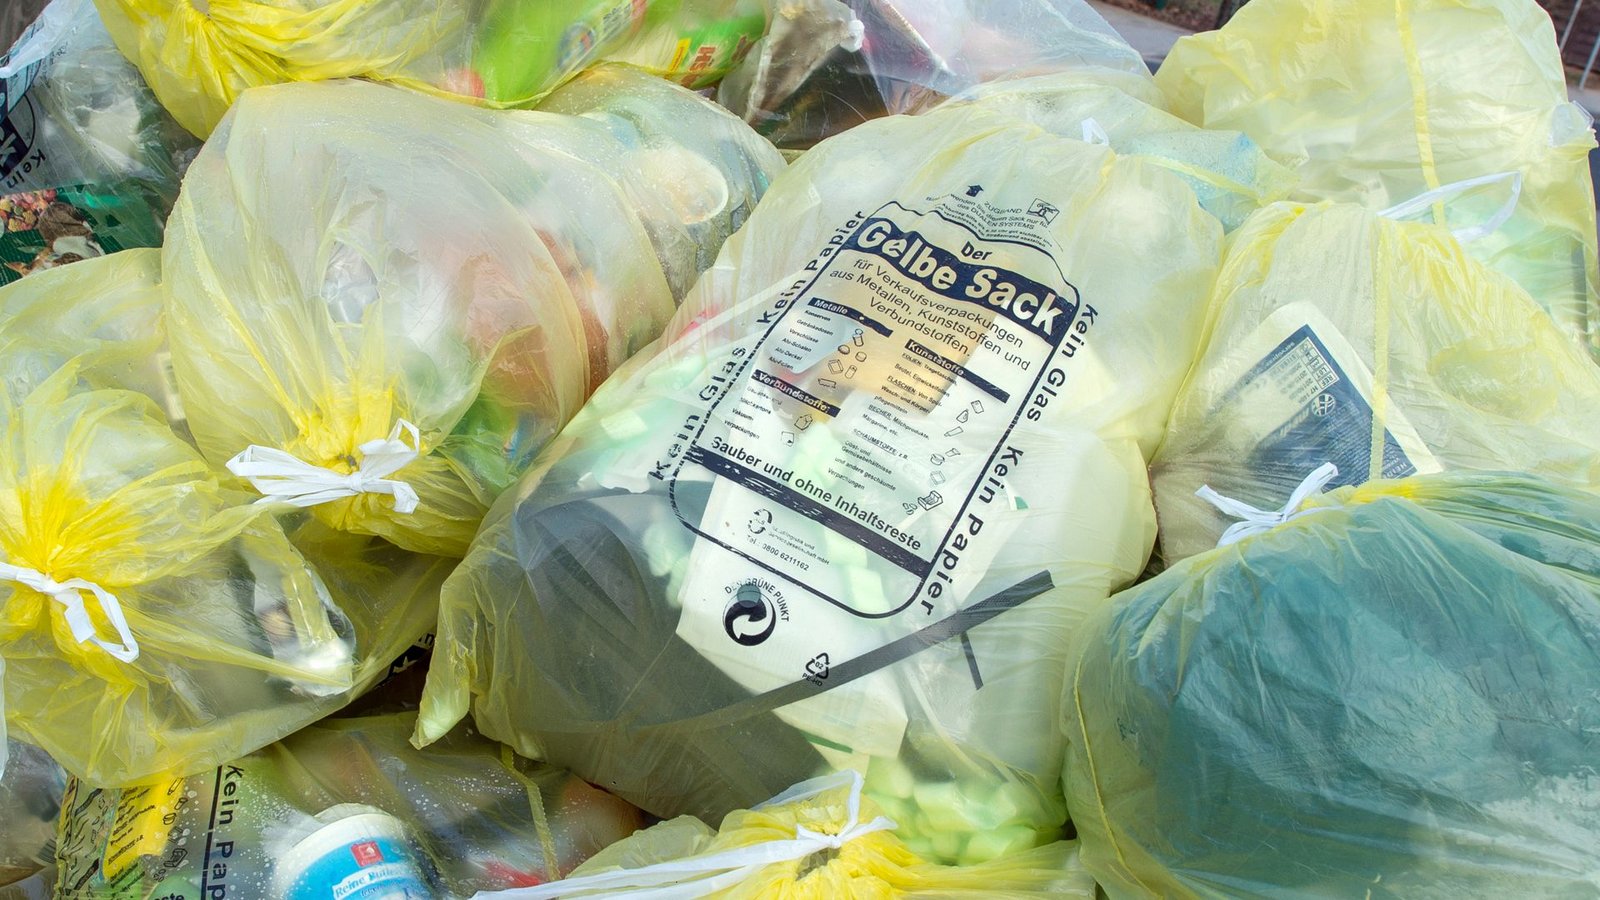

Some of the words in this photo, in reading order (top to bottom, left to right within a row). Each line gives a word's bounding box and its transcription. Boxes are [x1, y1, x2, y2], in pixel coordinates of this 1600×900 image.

[7, 148, 46, 189] Kein
[971, 206, 999, 227] DUALEN
[998, 221, 1035, 230] SYSTEMS
[1026, 217, 1038, 225] nur
[857, 220, 957, 291] Gelbe
[964, 269, 1064, 336] Sack
[961, 241, 993, 261] Der
[804, 310, 831, 322] Konserven
[814, 300, 849, 315] Metalle
[829, 269, 856, 282] aus
[856, 275, 912, 315] Metallen,
[917, 308, 1002, 356] Kunststoffen
[1004, 350, 1031, 371] und
[853, 258, 874, 272] für
[876, 264, 1024, 348] Verkaufsverpackungen
[870, 297, 971, 357] Verbundstoffen.
[1061, 303, 1099, 359] Kein
[648, 414, 700, 481] Kein
[699, 346, 747, 401] Glas
[756, 279, 806, 325] Kein
[804, 210, 866, 272] Papier
[1026, 367, 1067, 423] Glas
[1320, 374, 1334, 389] REF
[711, 436, 763, 468] Sauber
[763, 462, 794, 483] und
[795, 478, 832, 502] ohne
[835, 495, 921, 551] Inhaltsreste
[977, 445, 1025, 505] Kein
[780, 552, 809, 571] 6211162
[921, 512, 985, 617] Papier
[773, 590, 790, 622] PUNKT
[815, 661, 824, 670] 02
[219, 765, 244, 825] Kein
[207, 841, 234, 900] Pap
